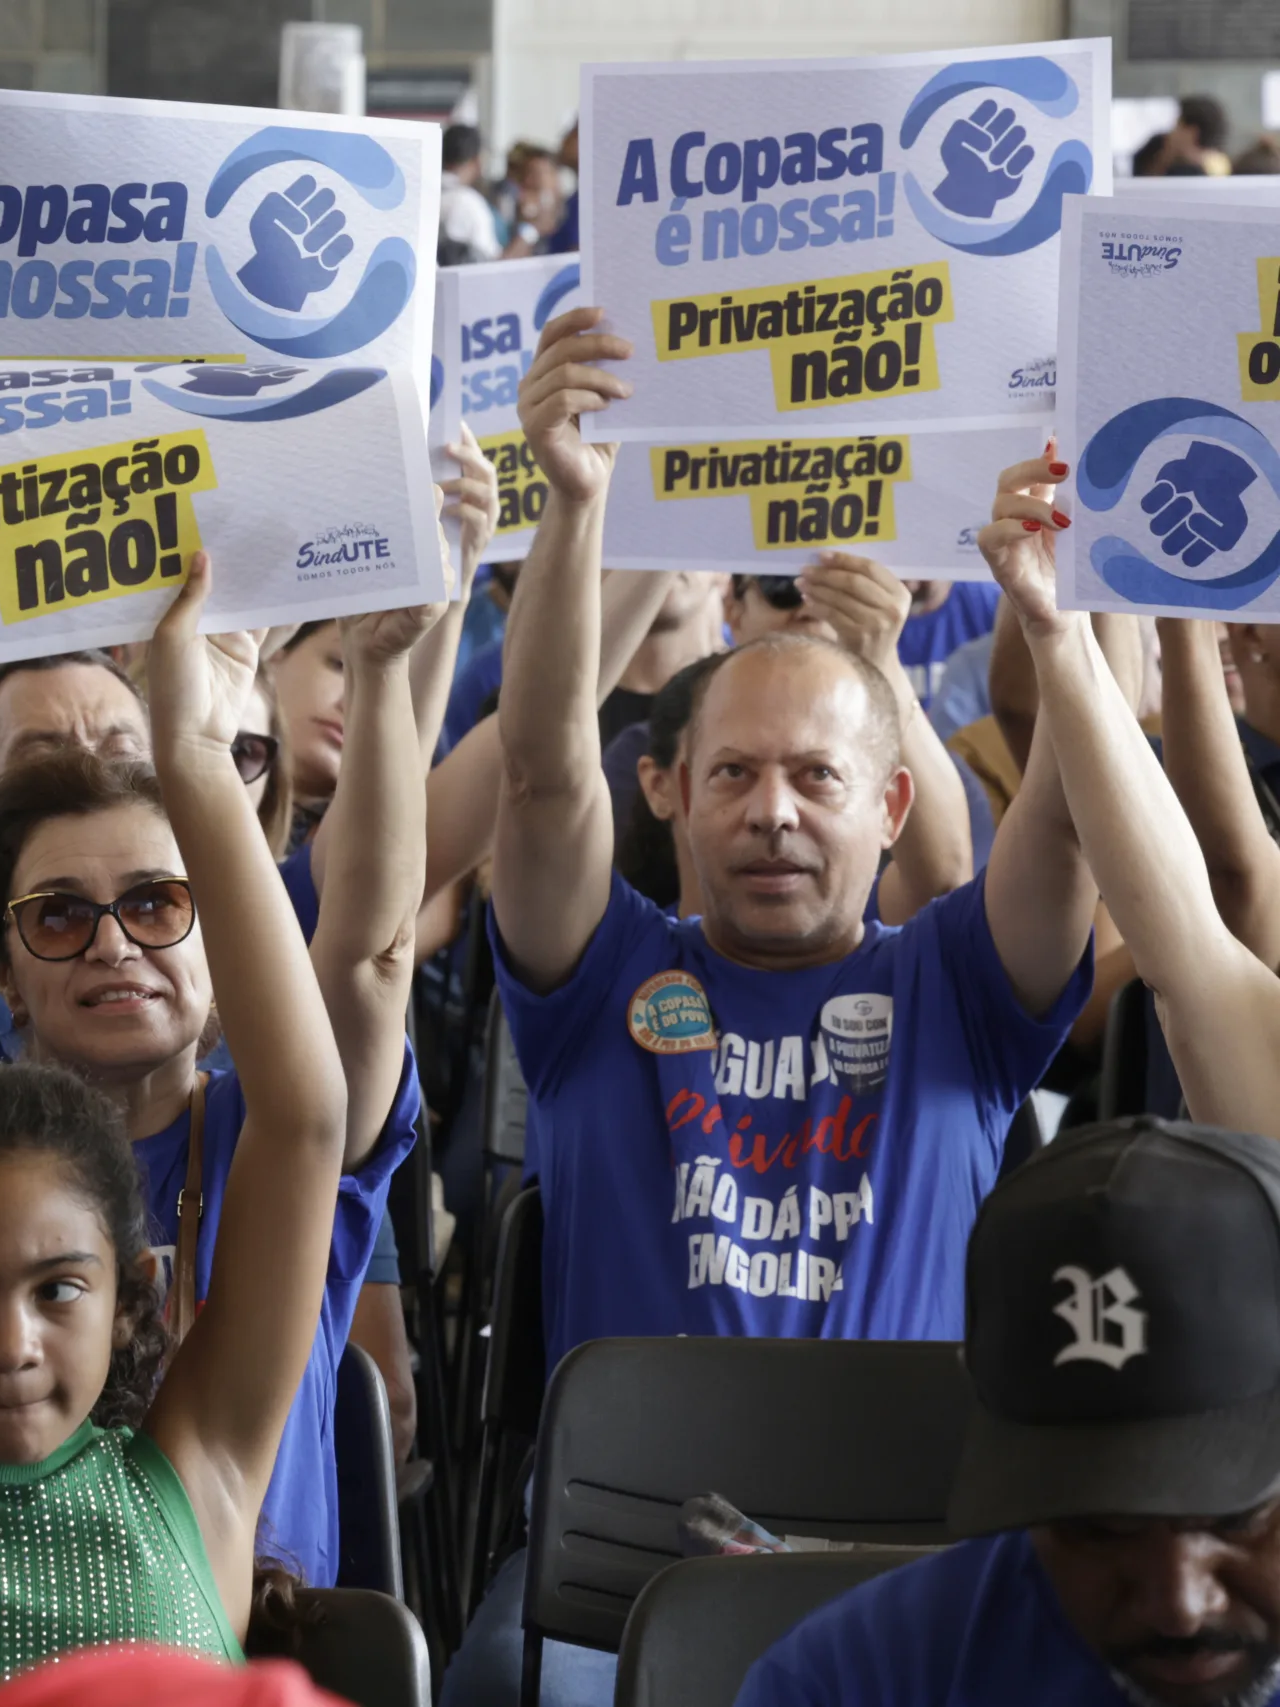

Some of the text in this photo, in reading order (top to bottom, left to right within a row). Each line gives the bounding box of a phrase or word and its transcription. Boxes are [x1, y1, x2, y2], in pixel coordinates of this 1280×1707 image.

[616, 122, 884, 206] A Copasa
[655, 171, 896, 266] é nossa!
[1101, 242, 1182, 269] SindUTE
[668, 269, 943, 351] Privatização
[790, 322, 922, 403] não!
[1008, 368, 1056, 389] SindU
[663, 436, 903, 492] Privatização
[766, 480, 883, 544] não!
[14, 492, 182, 611] não!
[296, 538, 391, 568] SindUTE
[866, 1016, 888, 1031] CON
[711, 1032, 806, 1101] GUA
[741, 1184, 801, 1241] DÁ
[1052, 1264, 1149, 1371] B
